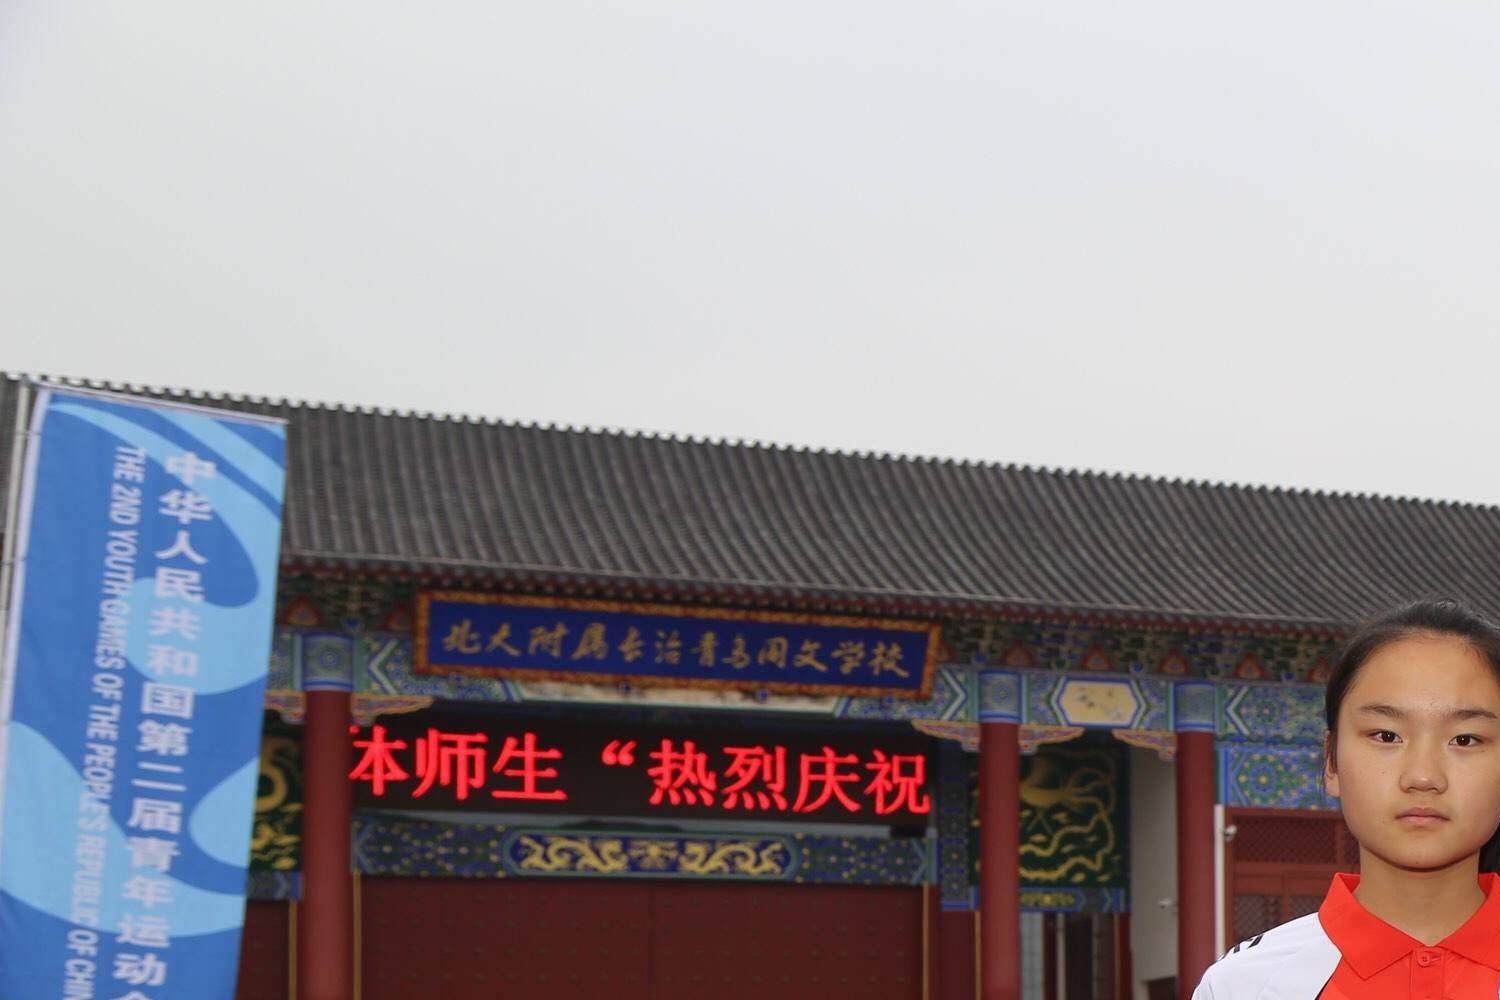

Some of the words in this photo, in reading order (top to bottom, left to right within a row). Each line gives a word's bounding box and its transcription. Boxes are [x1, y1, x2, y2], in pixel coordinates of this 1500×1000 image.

[113, 446, 147, 484] THE
[109, 483, 143, 526] 2ND
[101, 529, 140, 597] YOUTH
[93, 599, 131, 671] GAMES
[91, 672, 125, 702] OF
[86, 703, 122, 742] THE
[71, 834, 107, 928] REPUBLIC
[66, 928, 99, 958] OF
